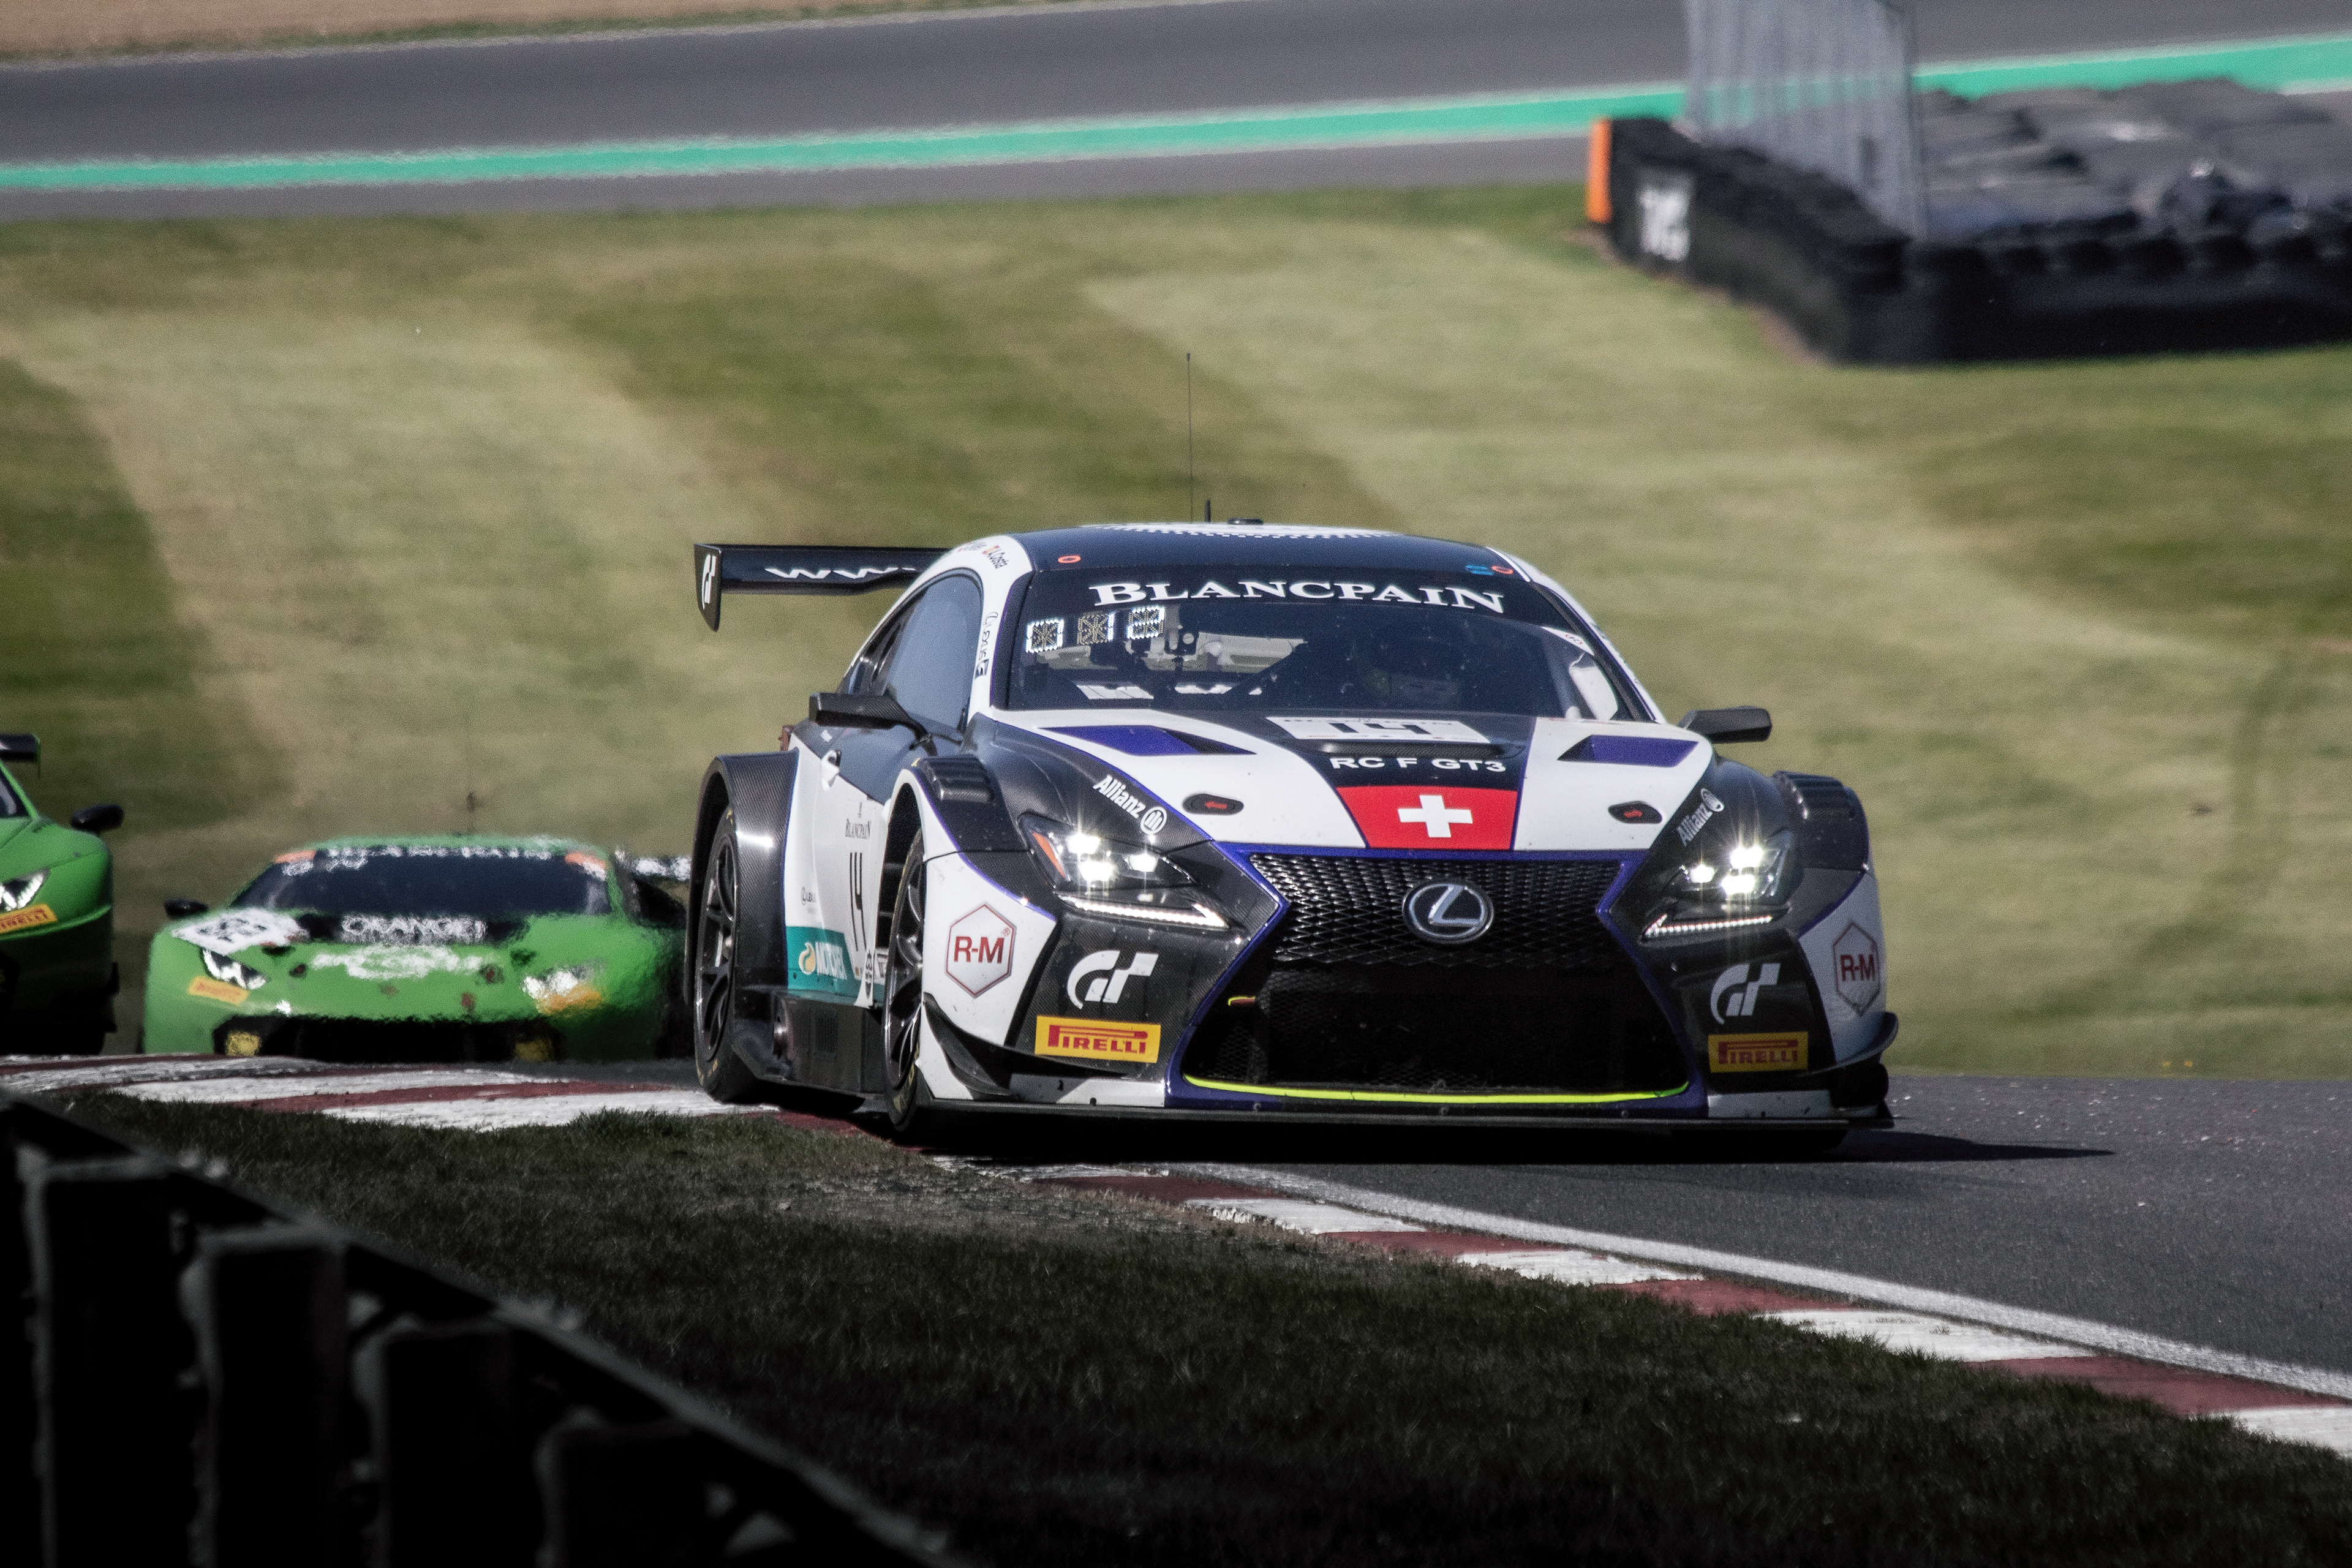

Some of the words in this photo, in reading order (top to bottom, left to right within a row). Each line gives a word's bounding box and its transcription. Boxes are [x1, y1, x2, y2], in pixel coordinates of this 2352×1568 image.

[1090, 581, 1504, 614] BLANCPAIN
[1329, 757, 1385, 769] RC
[1396, 757, 1418, 769] F
[1431, 759, 1507, 773] GT3
[1092, 774, 1147, 820] Allianz
[1676, 803, 1714, 848] Allianz
[954, 935, 1005, 964] R-M
[1840, 953, 1875, 981] R-M
[1048, 1023, 1149, 1055] PIRELLI
[1718, 1039, 1799, 1065] PIRELLI
